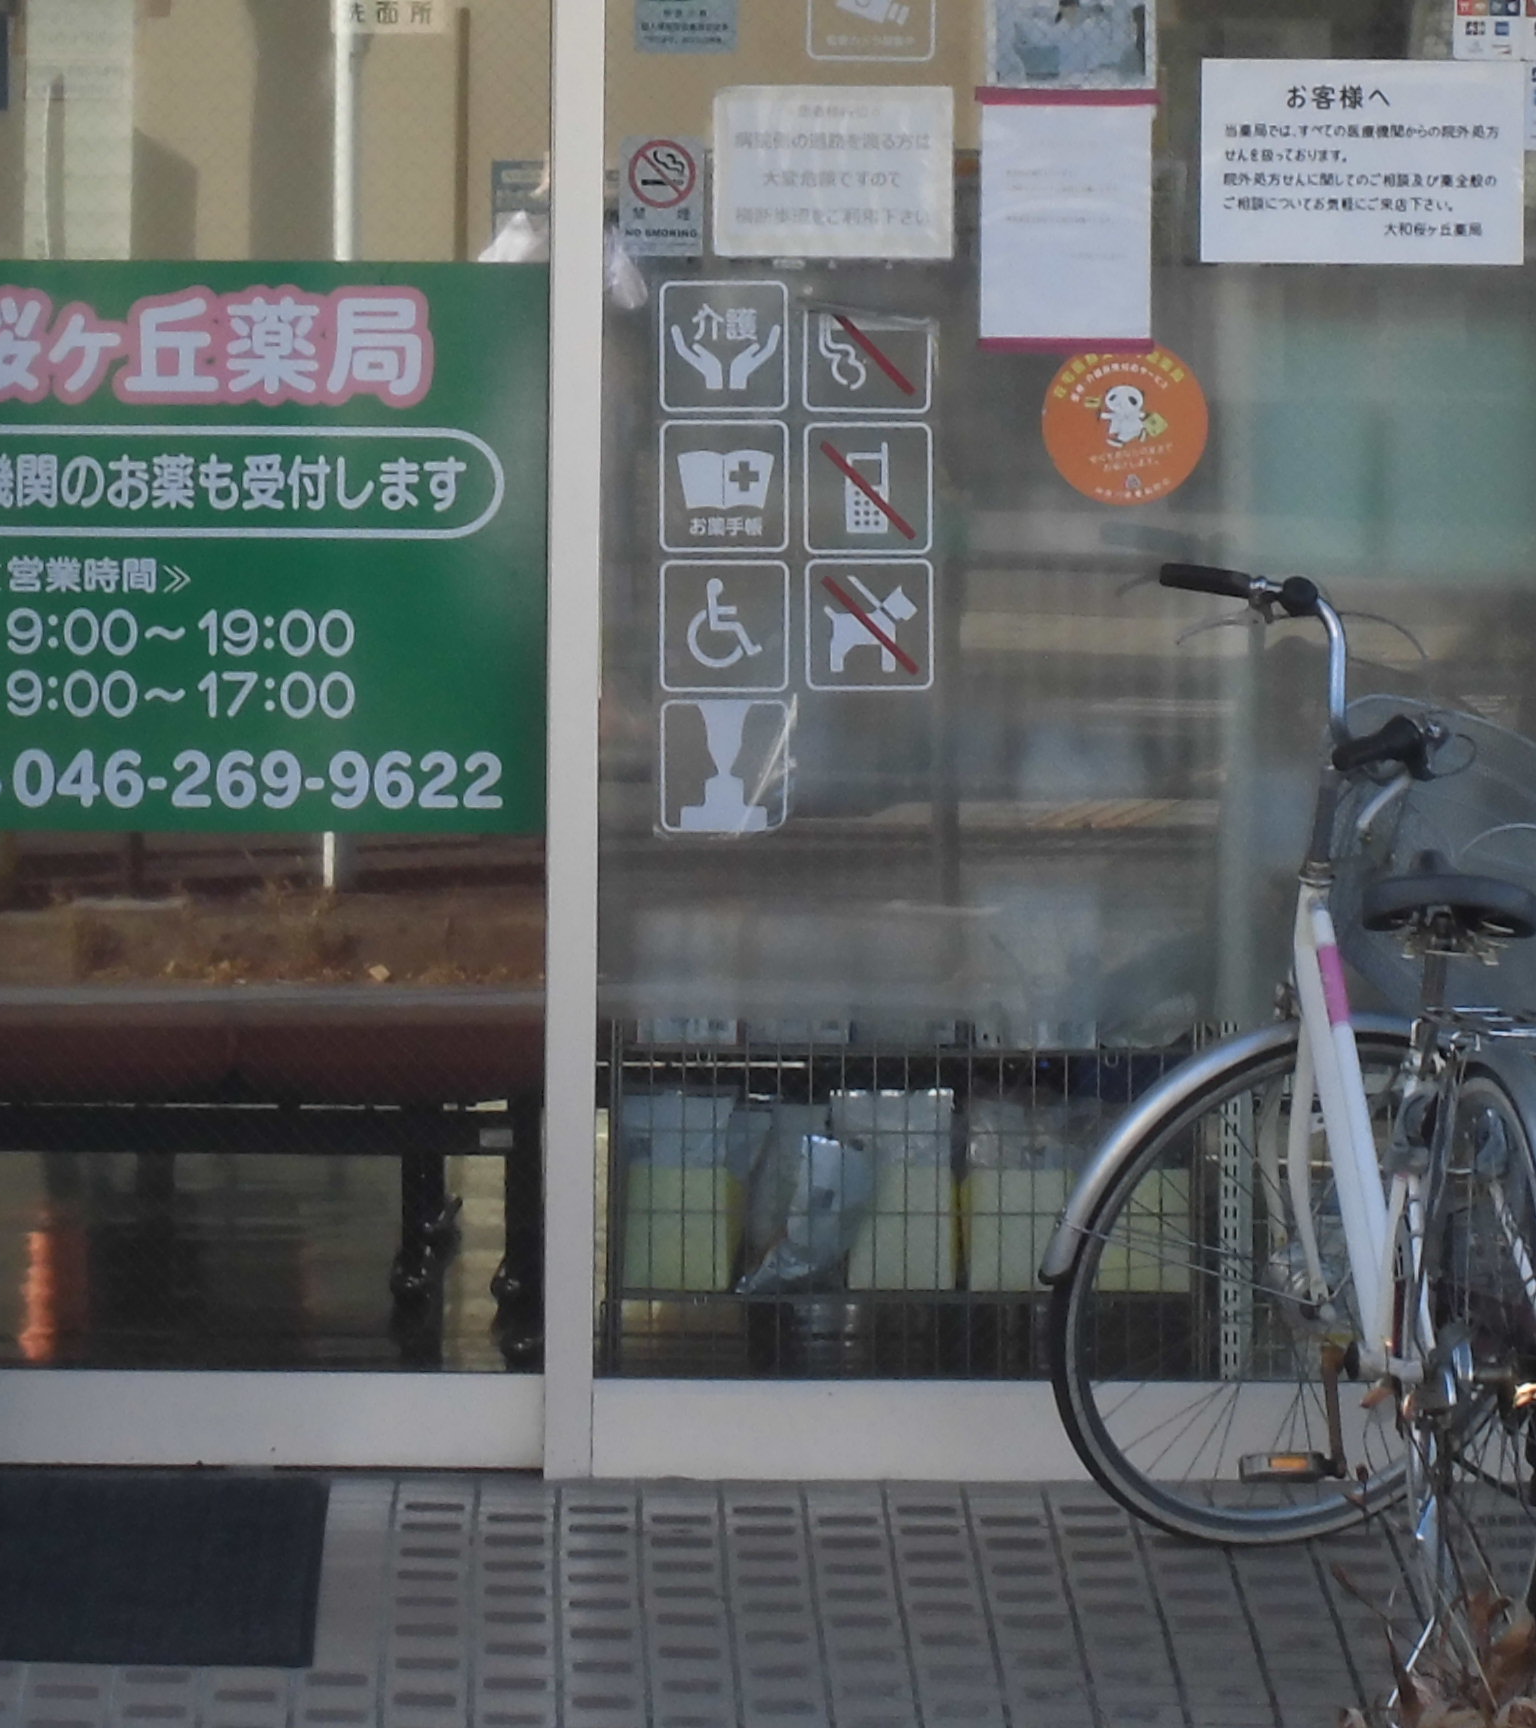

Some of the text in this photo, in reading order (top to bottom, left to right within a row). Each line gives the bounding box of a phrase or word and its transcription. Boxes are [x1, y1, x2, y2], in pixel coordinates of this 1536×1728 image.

[1286, 84, 1391, 110] お客様へ
[691, 302, 758, 341] 介護
[689, 516, 763, 537] お薬手帳
[12, 749, 504, 810] 046-269-9622
